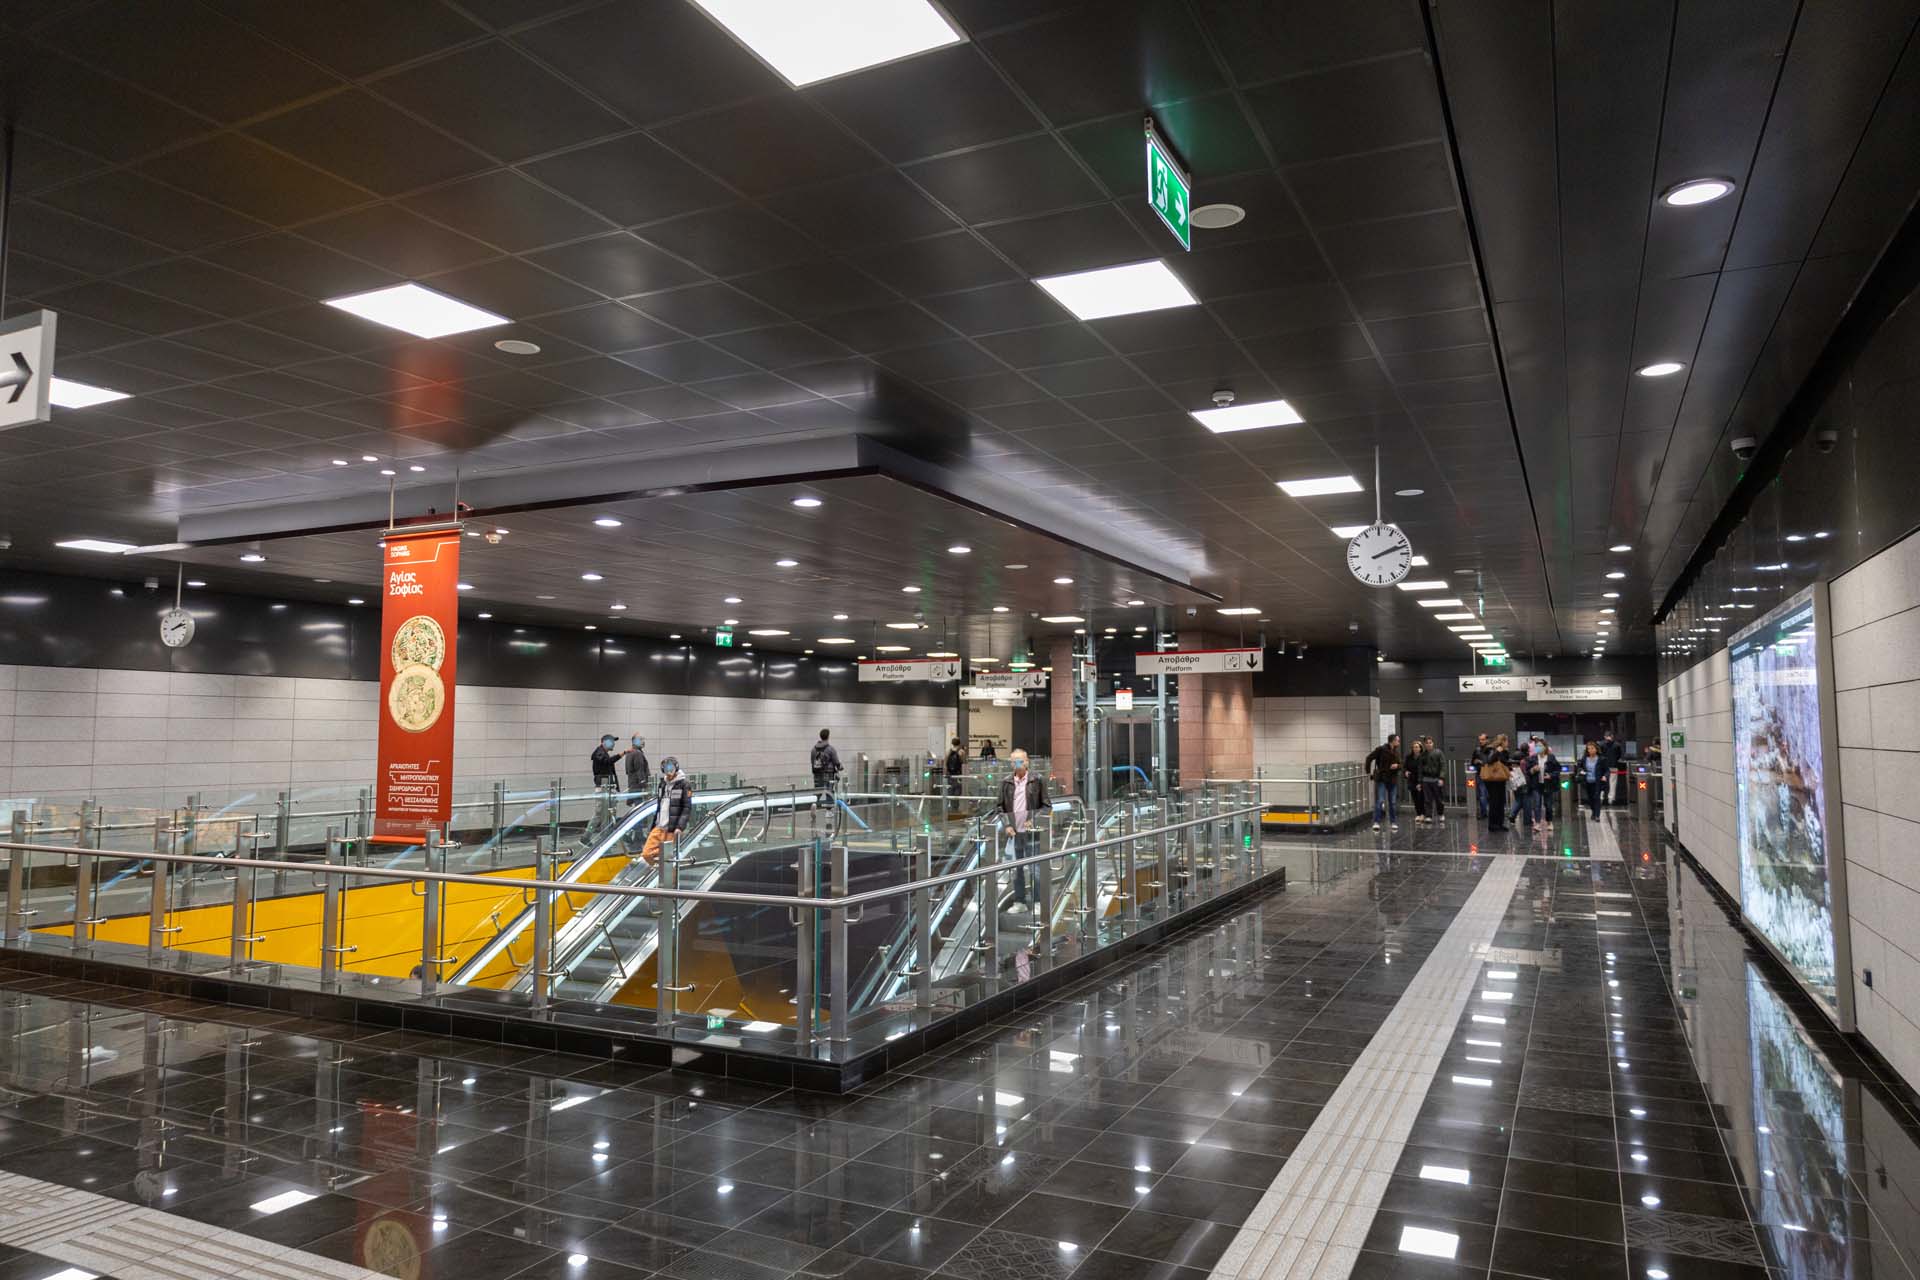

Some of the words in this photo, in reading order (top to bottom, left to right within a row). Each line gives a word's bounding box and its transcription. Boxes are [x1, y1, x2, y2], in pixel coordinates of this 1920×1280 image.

[390, 571, 416, 584] Αγίας
[389, 583, 424, 597] Σοφίας
[1158, 655, 1200, 664] Αποβάθρα
[875, 665, 912, 673] Αποβάθρα
[980, 674, 1013, 682] Αποβάθρα
